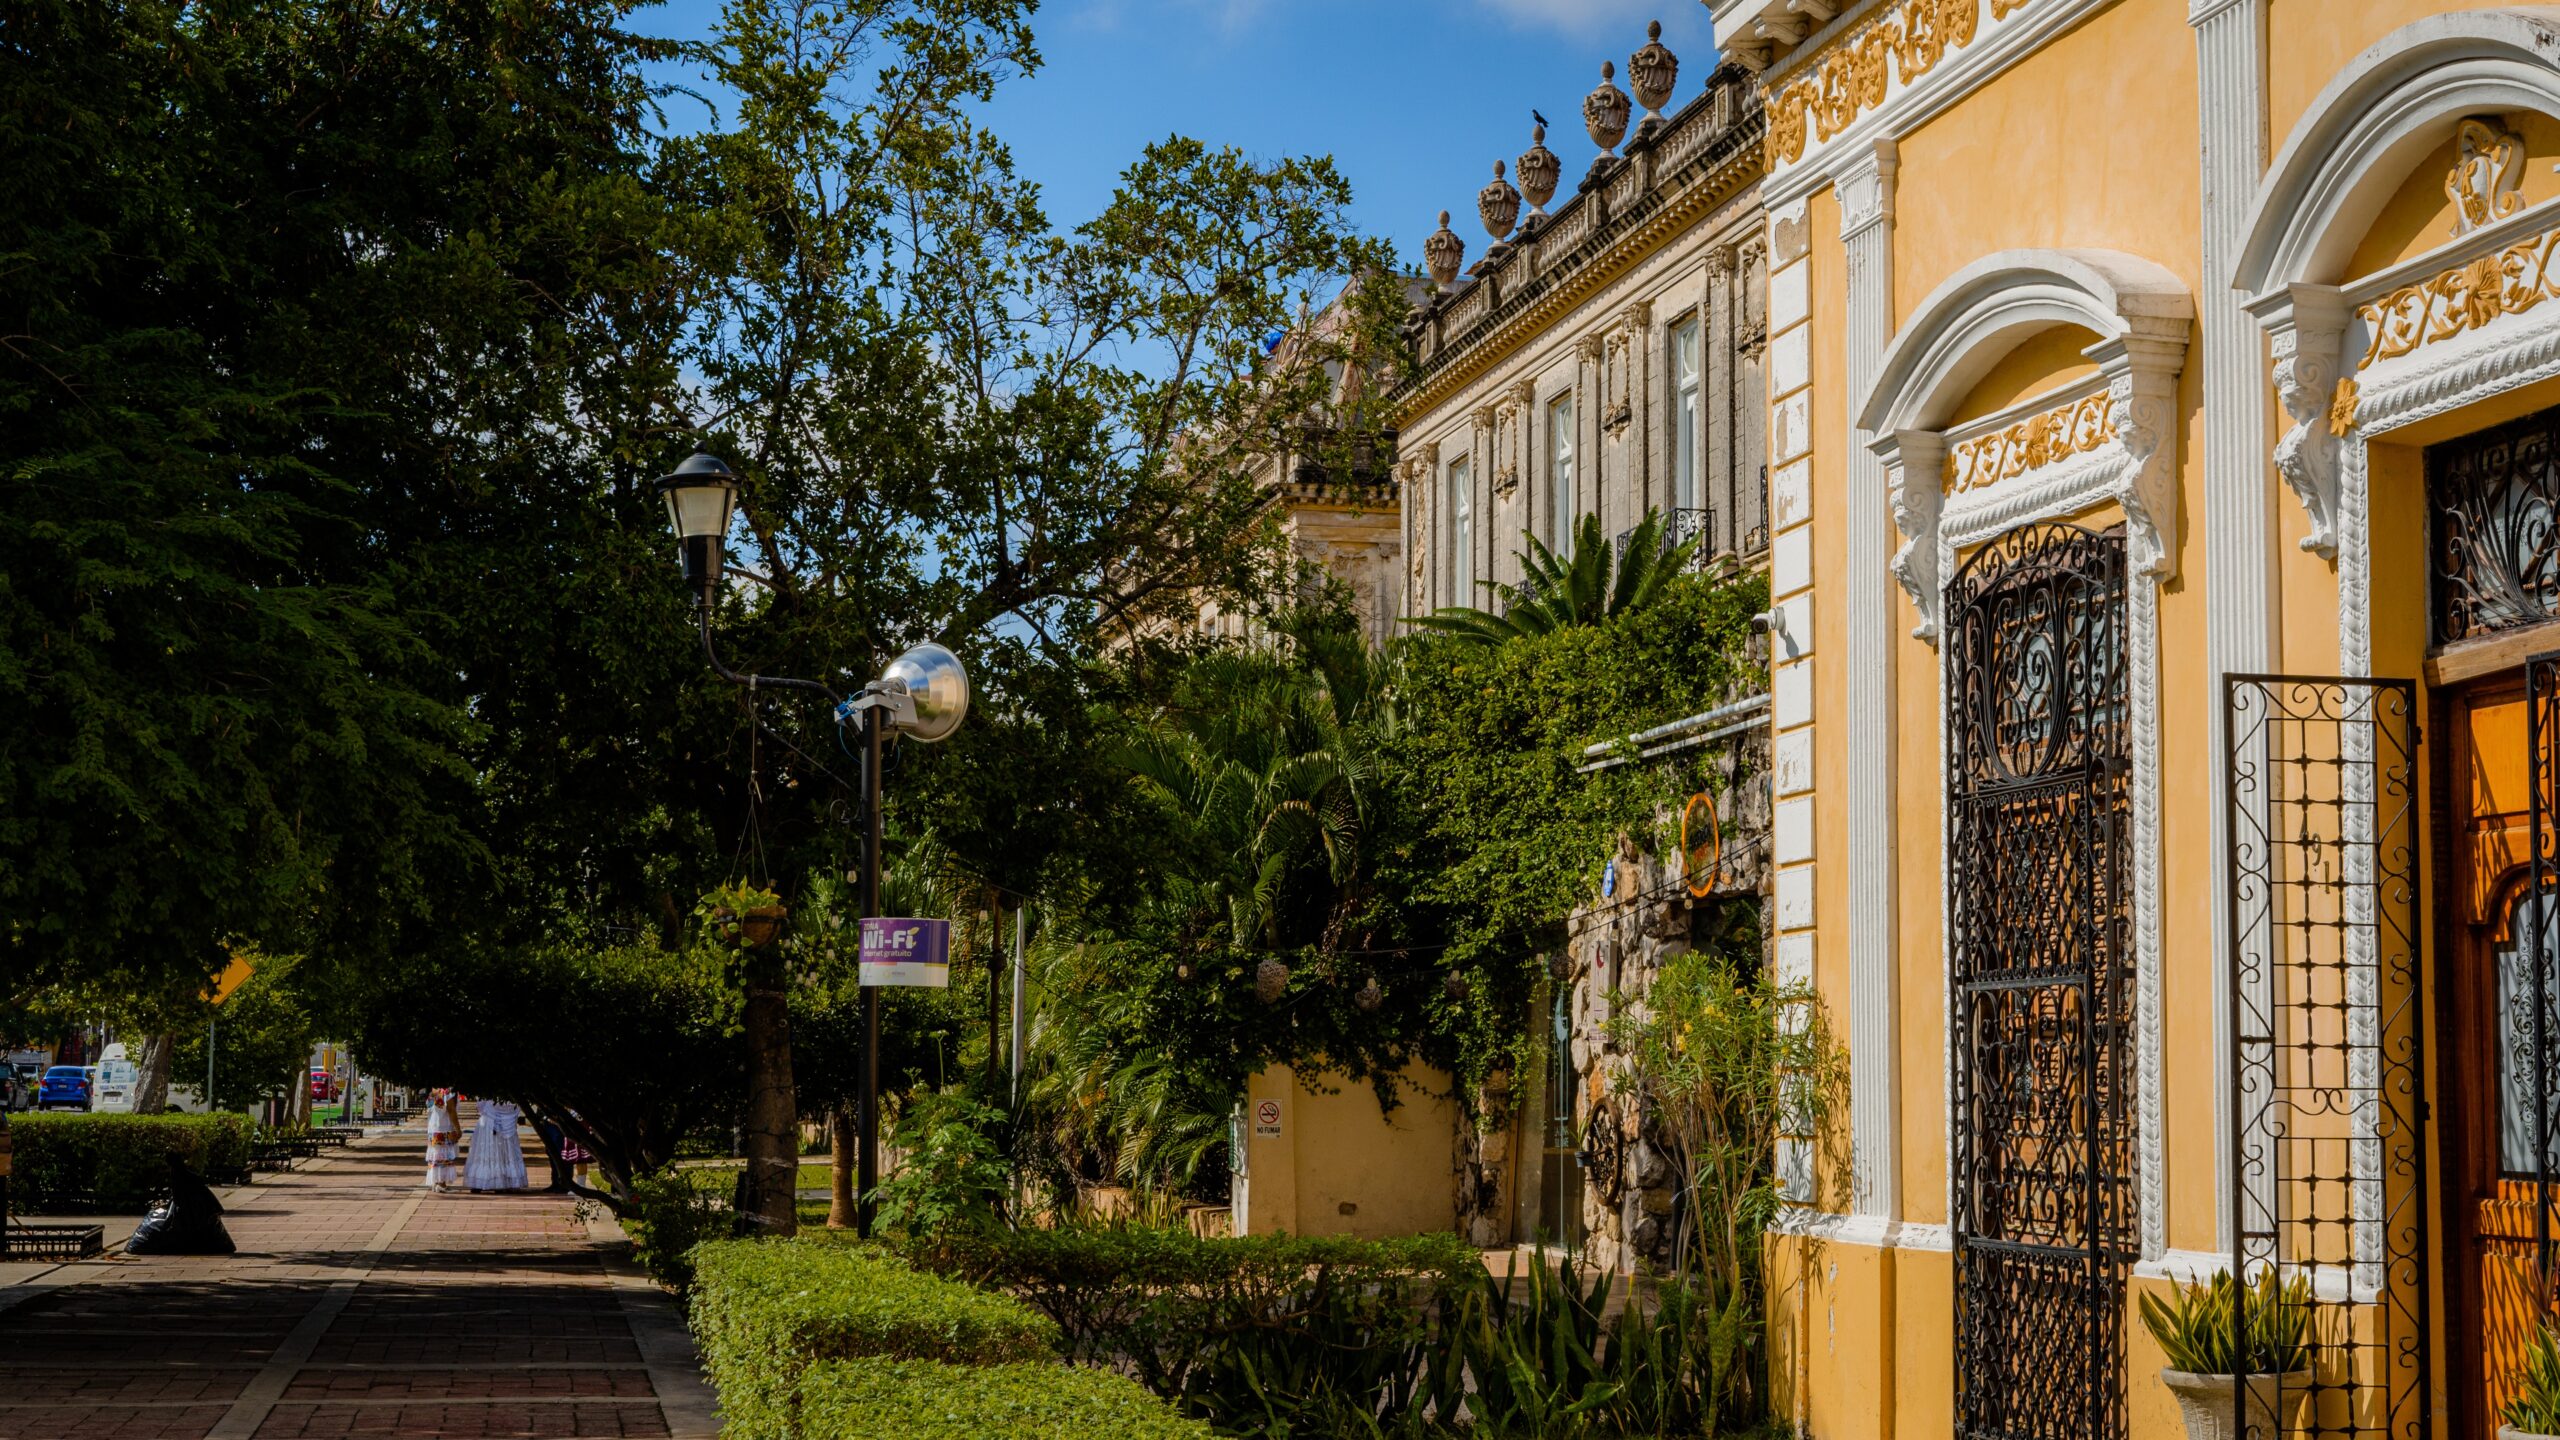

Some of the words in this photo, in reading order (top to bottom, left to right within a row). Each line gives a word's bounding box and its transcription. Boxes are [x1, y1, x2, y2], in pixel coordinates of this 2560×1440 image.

[864, 929, 914, 948] Wi-Fi
[884, 950, 912, 958] gratuito
[1257, 1126, 1263, 1134] NO
[1264, 1126, 1280, 1134] FUMAR
